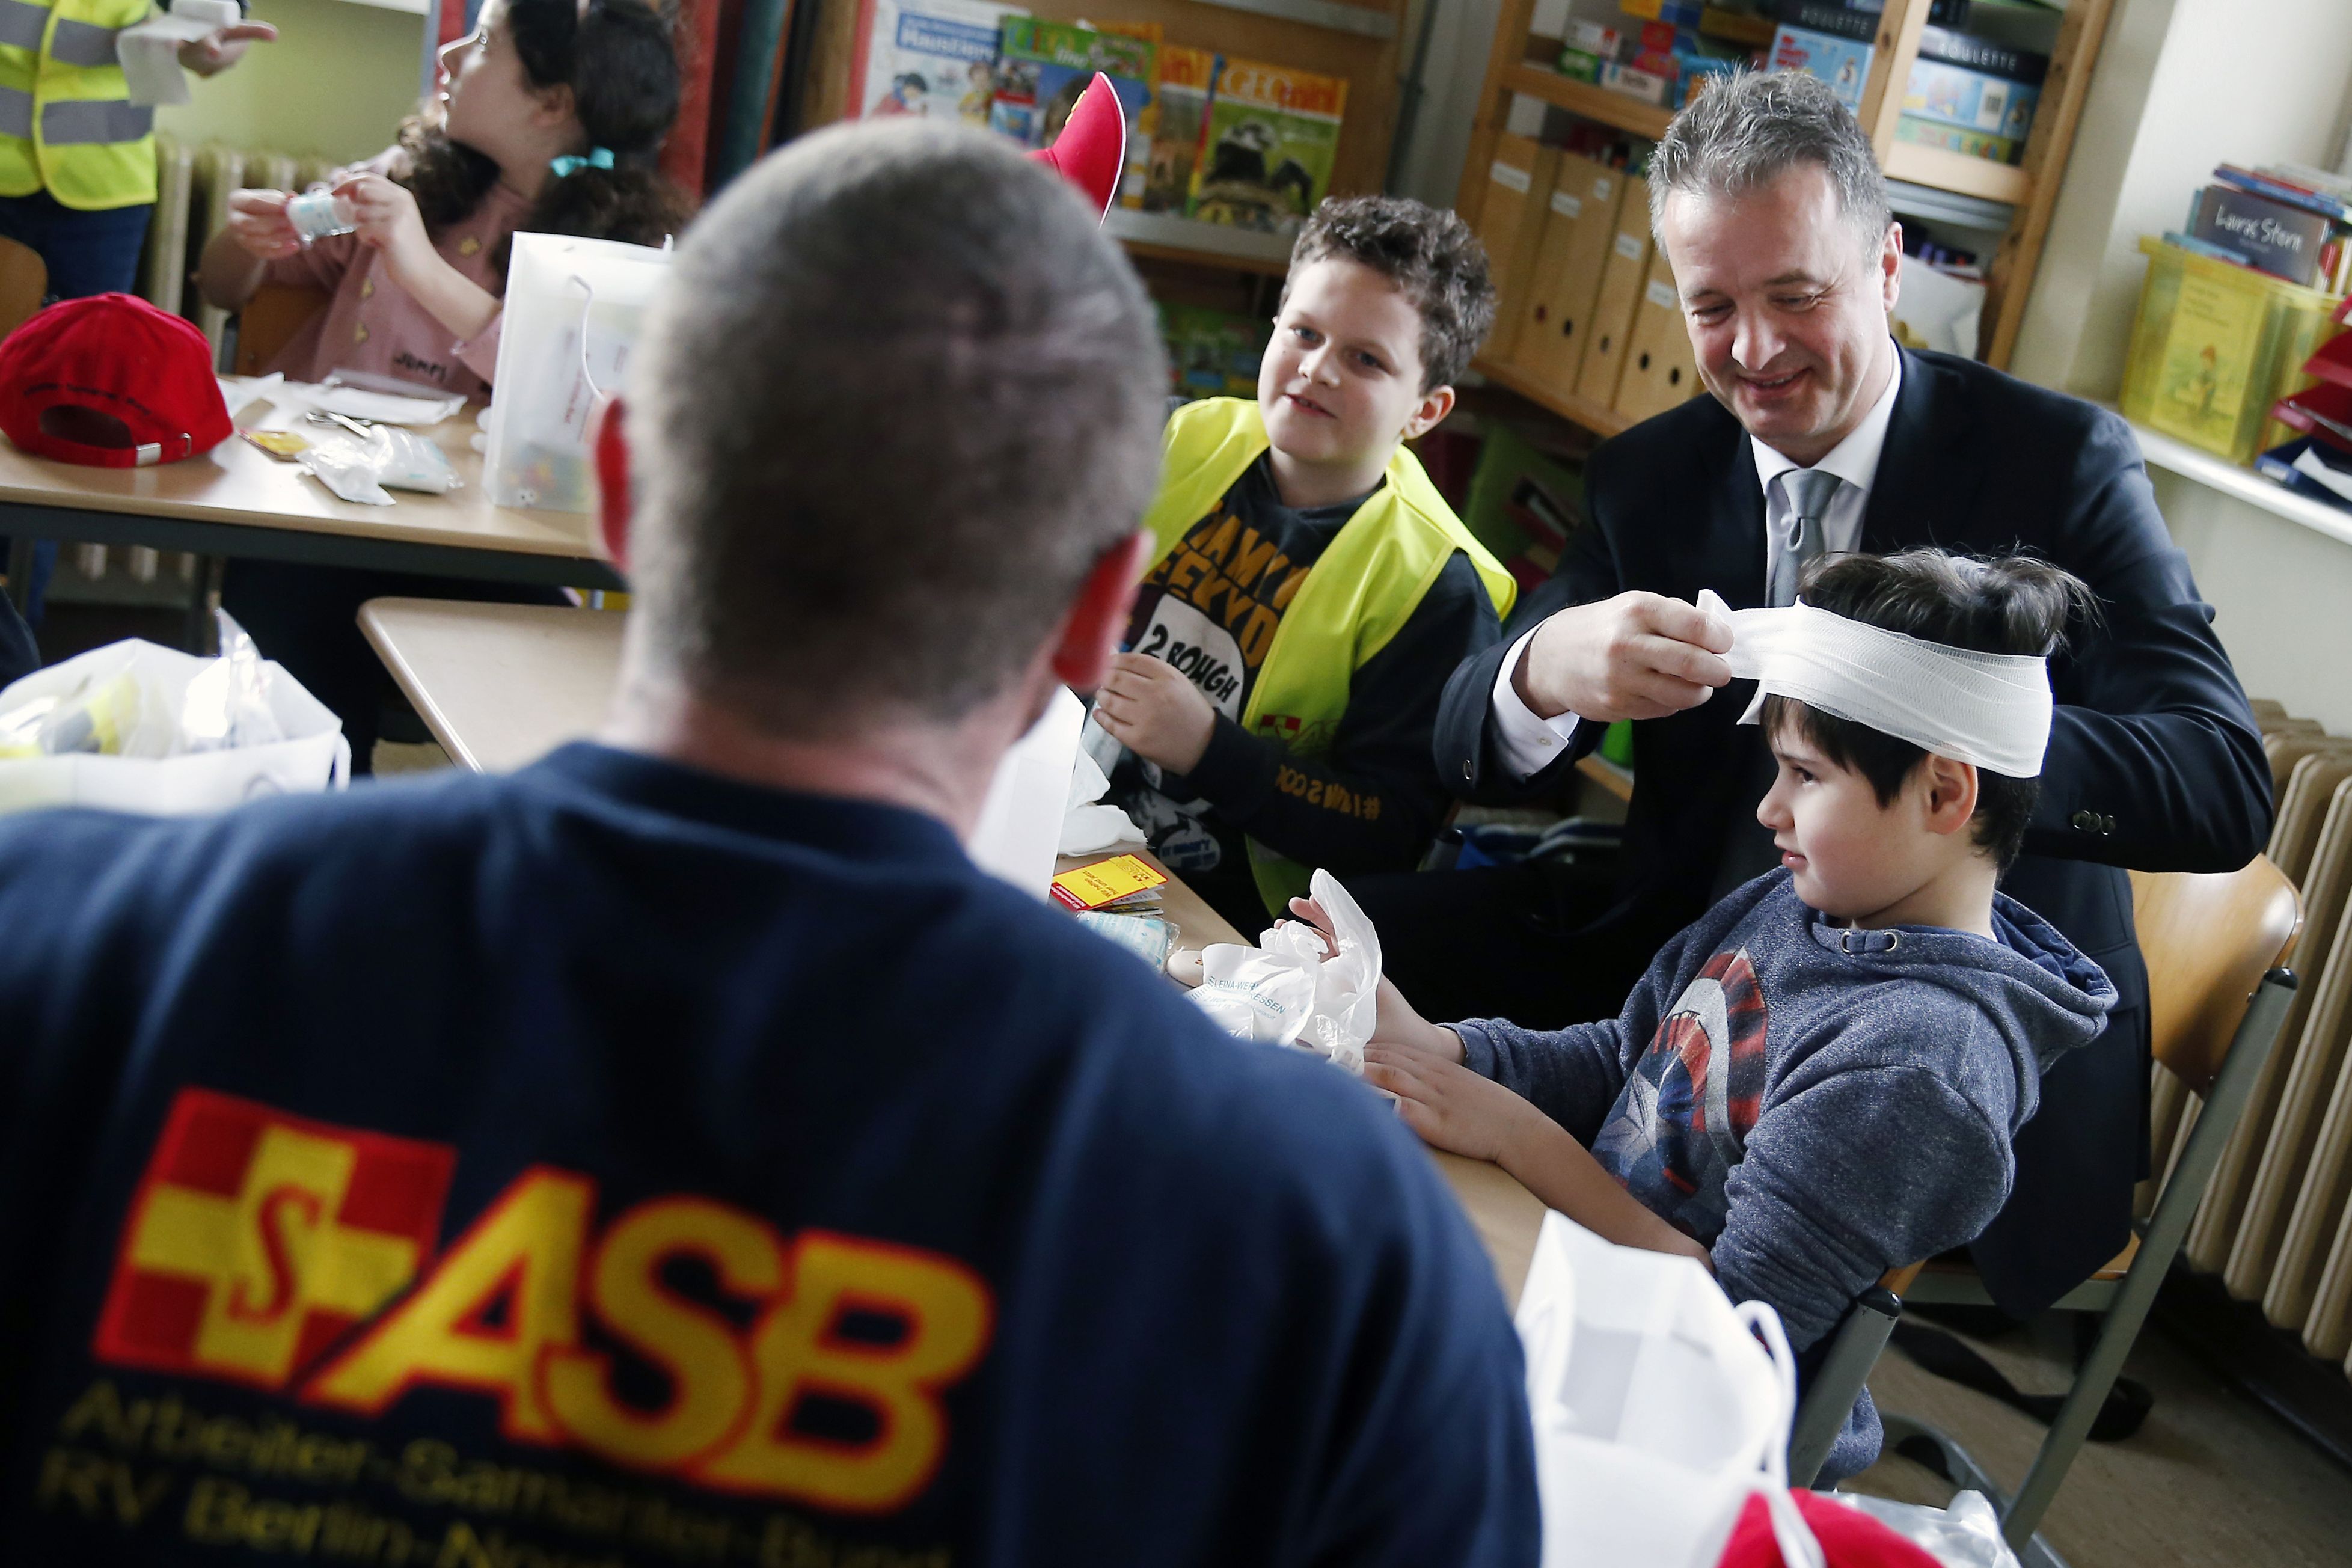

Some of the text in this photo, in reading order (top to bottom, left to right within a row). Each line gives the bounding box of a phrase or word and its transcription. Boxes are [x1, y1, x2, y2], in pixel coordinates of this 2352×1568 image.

[1937, 41, 2017, 72] ROULETTE
[2260, 217, 2303, 253] Stern
[1141, 623, 1169, 658] 2
[225, 1183, 322, 1328] S
[304, 1162, 997, 1515] ASB
